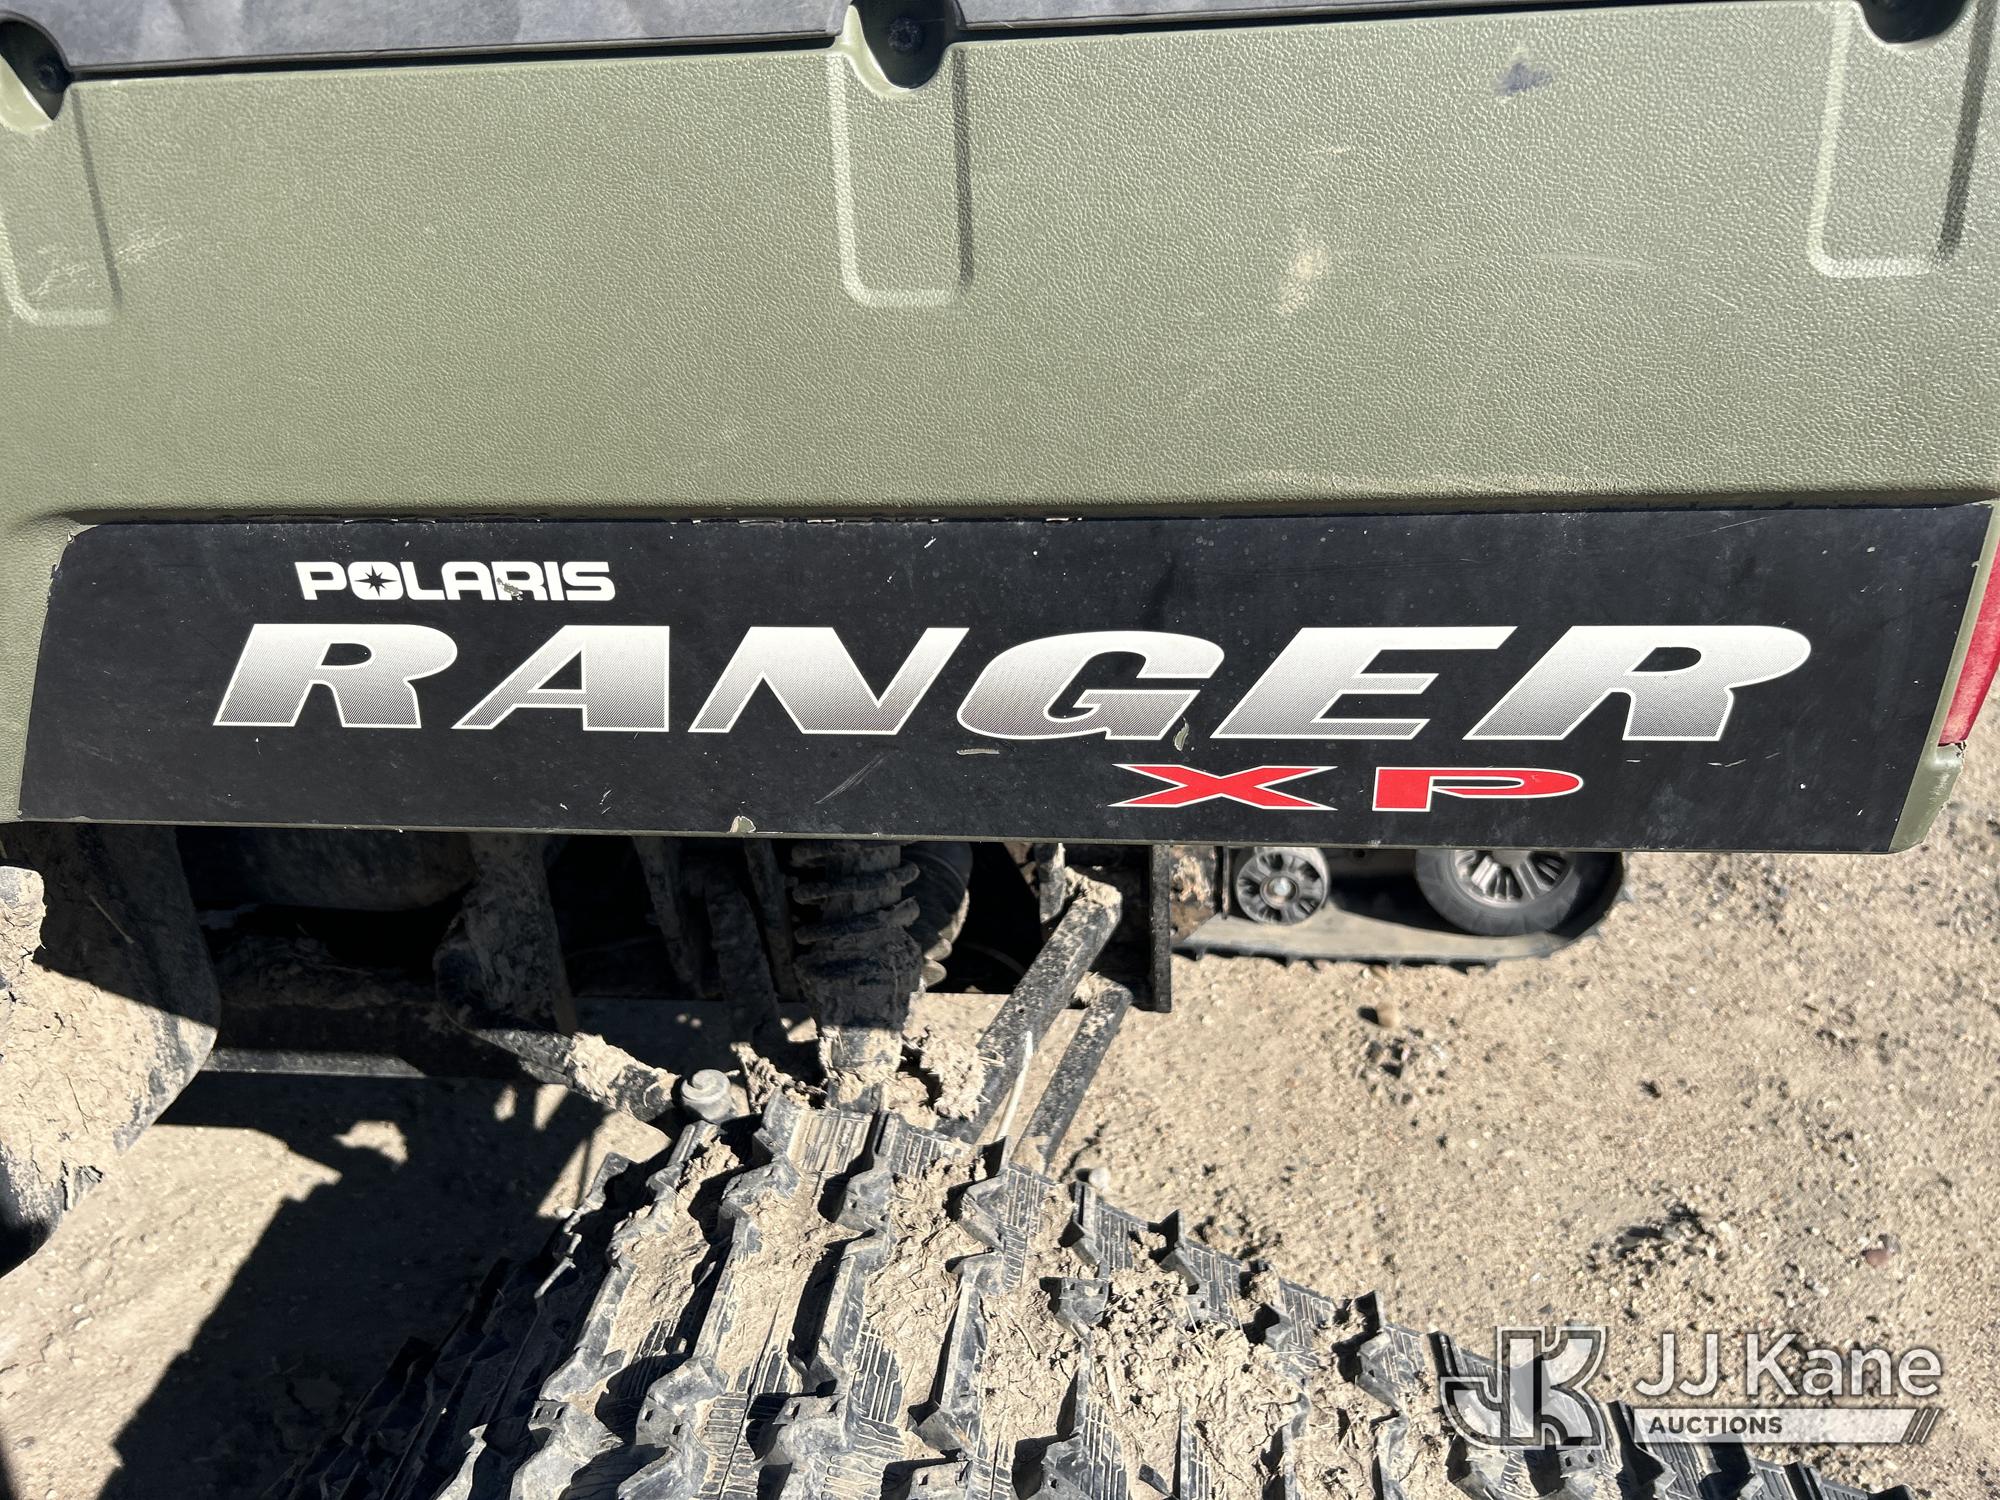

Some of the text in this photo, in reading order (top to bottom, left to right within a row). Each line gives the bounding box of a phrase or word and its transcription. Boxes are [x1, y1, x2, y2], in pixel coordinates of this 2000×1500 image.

[294, 560, 616, 602] POLARIS
[211, 622, 1813, 742] RANGER
[1107, 763, 1585, 813] XP
